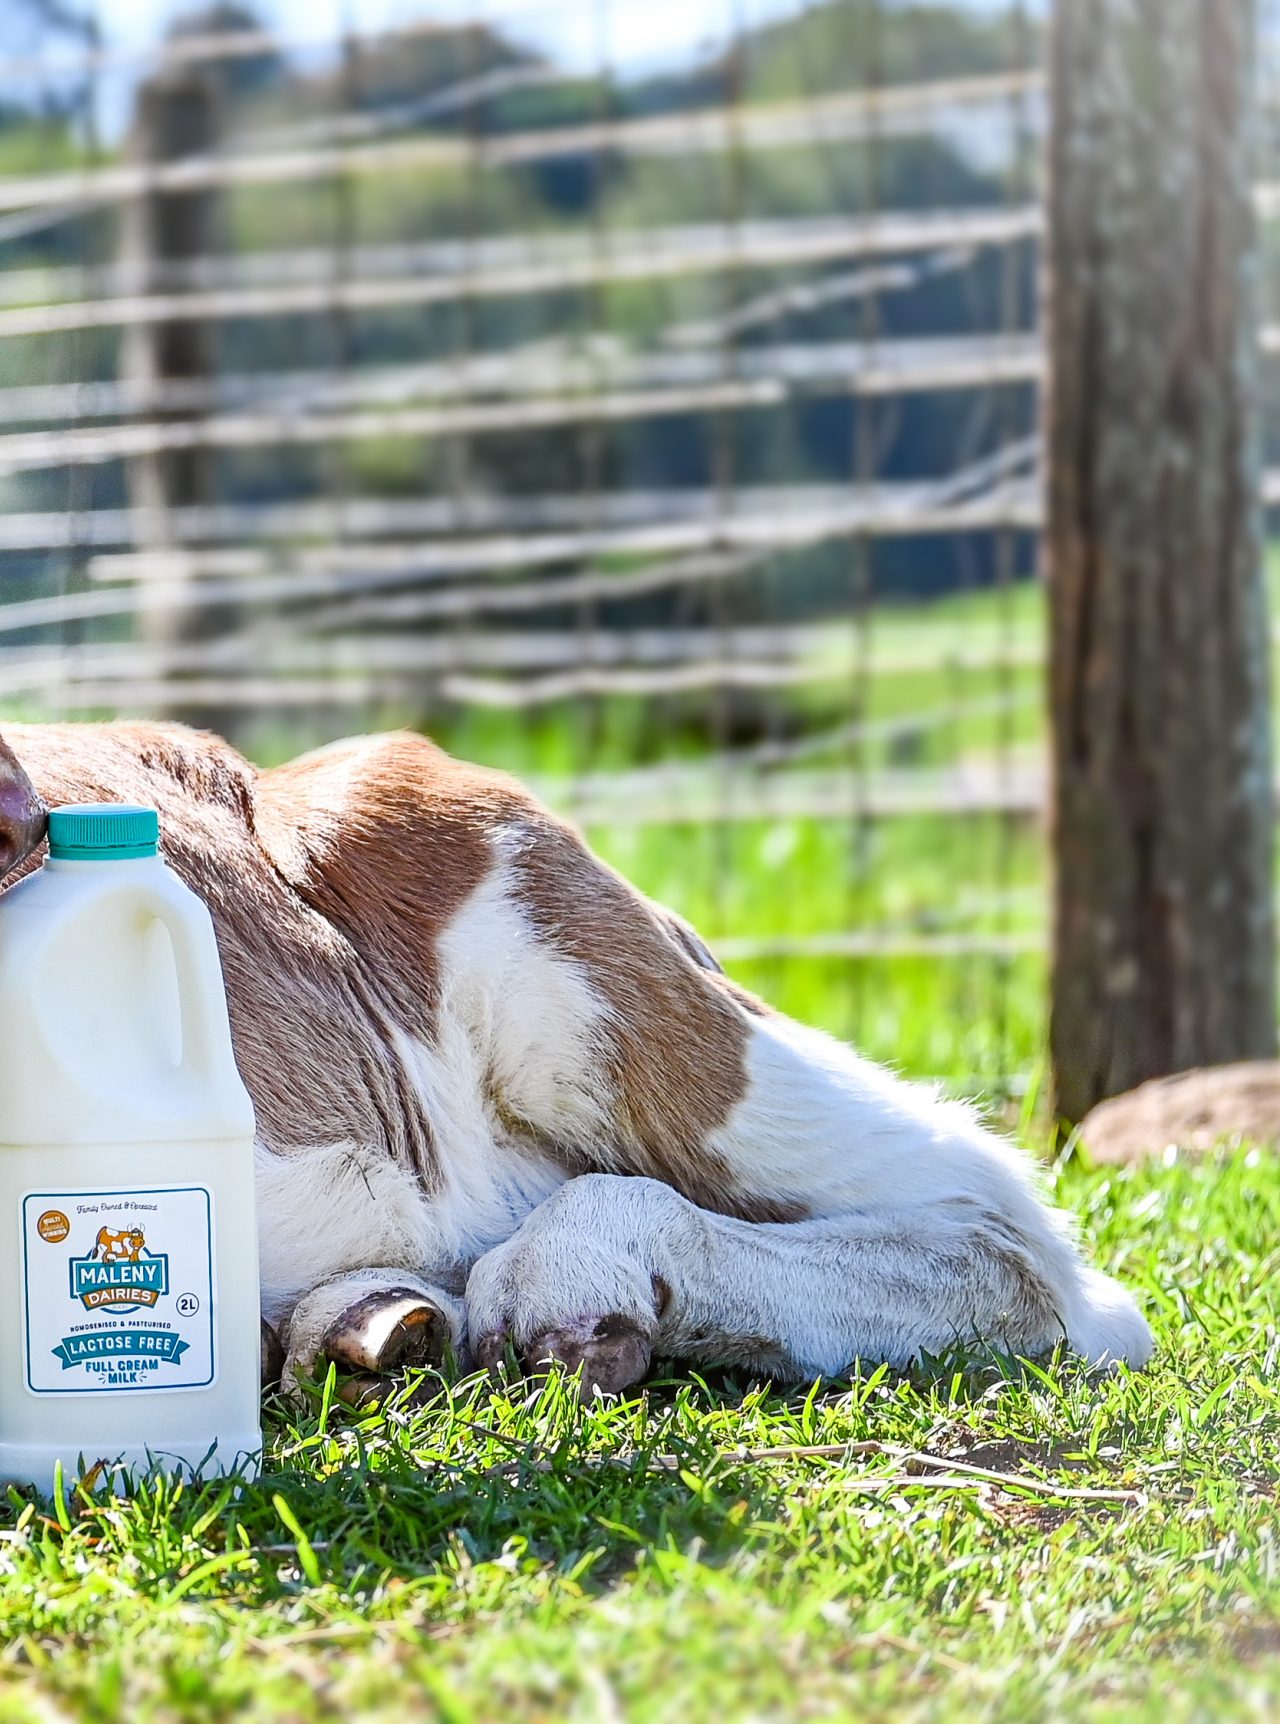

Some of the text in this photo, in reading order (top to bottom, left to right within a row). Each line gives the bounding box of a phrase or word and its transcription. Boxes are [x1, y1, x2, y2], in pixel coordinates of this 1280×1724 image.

[80, 1265, 157, 1284] MALENY
[88, 1288, 151, 1305] DAIRIES
[181, 1299, 196, 1310] 2L
[70, 1321, 117, 1332] HOMOGENISED
[128, 1320, 171, 1329] PASTEURISED
[70, 1336, 171, 1355] LACTOSE FREE
[86, 1359, 159, 1373] FULL CREAM
[108, 1372, 137, 1384] MILK
